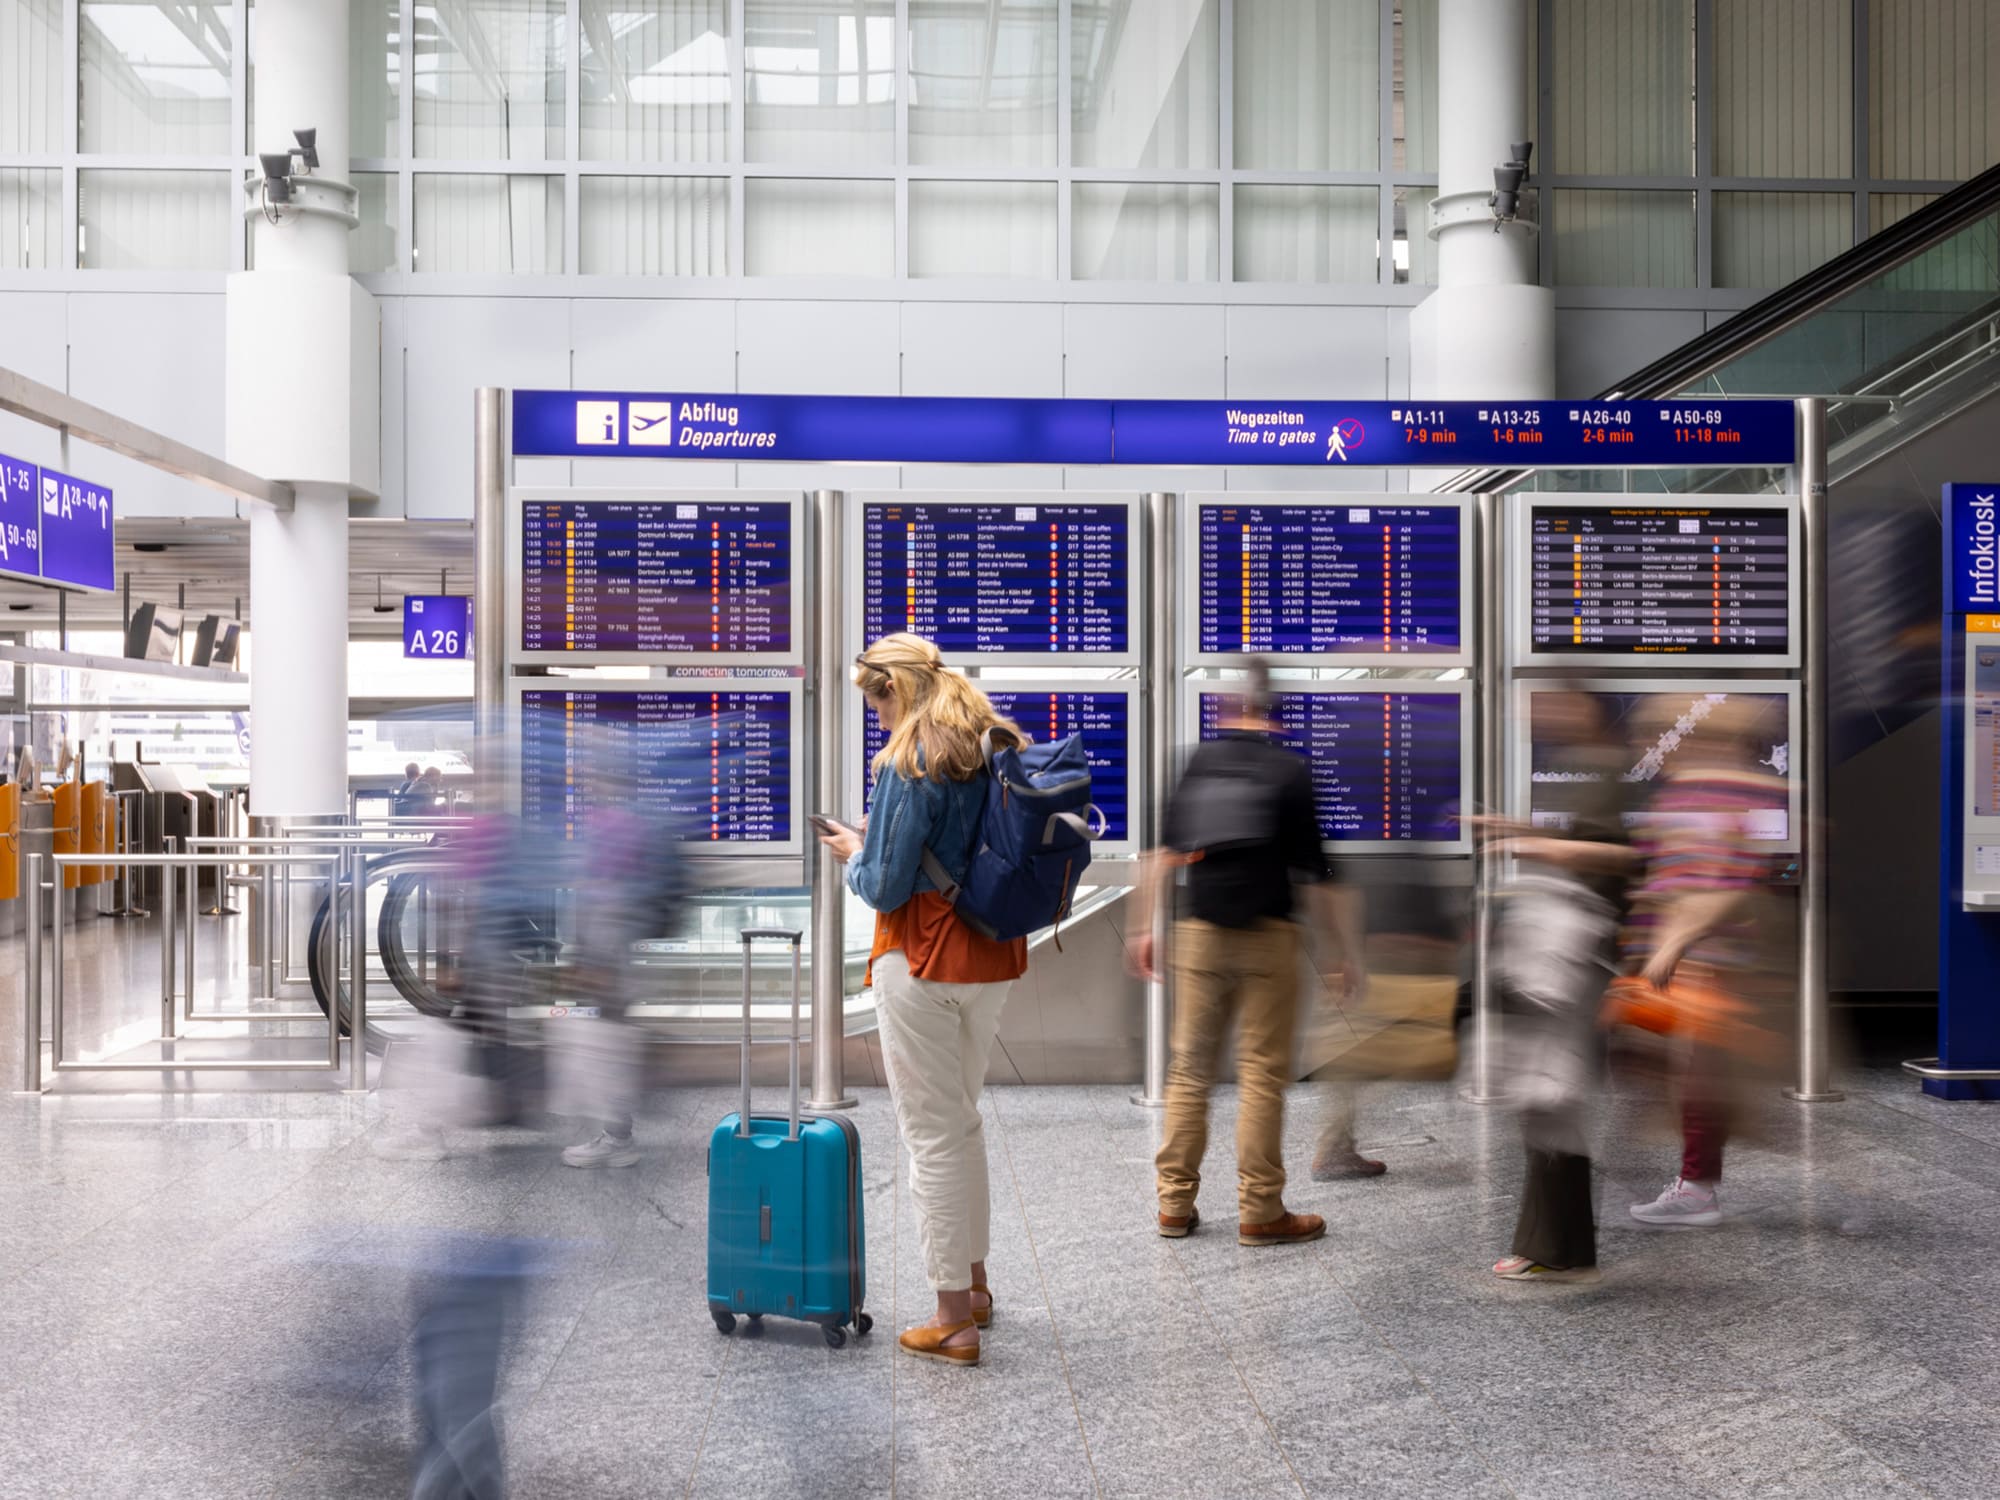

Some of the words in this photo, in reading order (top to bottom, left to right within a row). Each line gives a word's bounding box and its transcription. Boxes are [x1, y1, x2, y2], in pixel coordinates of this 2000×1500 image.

[678, 402, 739, 426] Abflug
[1226, 410, 1304, 428] Wegezeiten
[678, 427, 777, 451] Departures
[1228, 428, 1259, 443] Time
[1262, 430, 1276, 443] to
[1279, 430, 1317, 447] gates
[1405, 428, 1428, 443] 7-9
[1431, 428, 1457, 443] min
[1493, 428, 1514, 443] 1-6
[1518, 428, 1543, 443] min
[1583, 428, 1605, 443] 2-6
[1609, 428, 1634, 443] min
[1675, 428, 1712, 442] 11-18
[1716, 428, 1741, 442] min
[745, 523, 757, 531] Zug
[745, 532, 757, 540] Zug
[1968, 493, 1995, 603] Infokiosk
[745, 569, 757, 577] Zug
[1416, 627, 1427, 635] Zug
[675, 667, 735, 679] connecting
[745, 703, 756, 712] Zug
